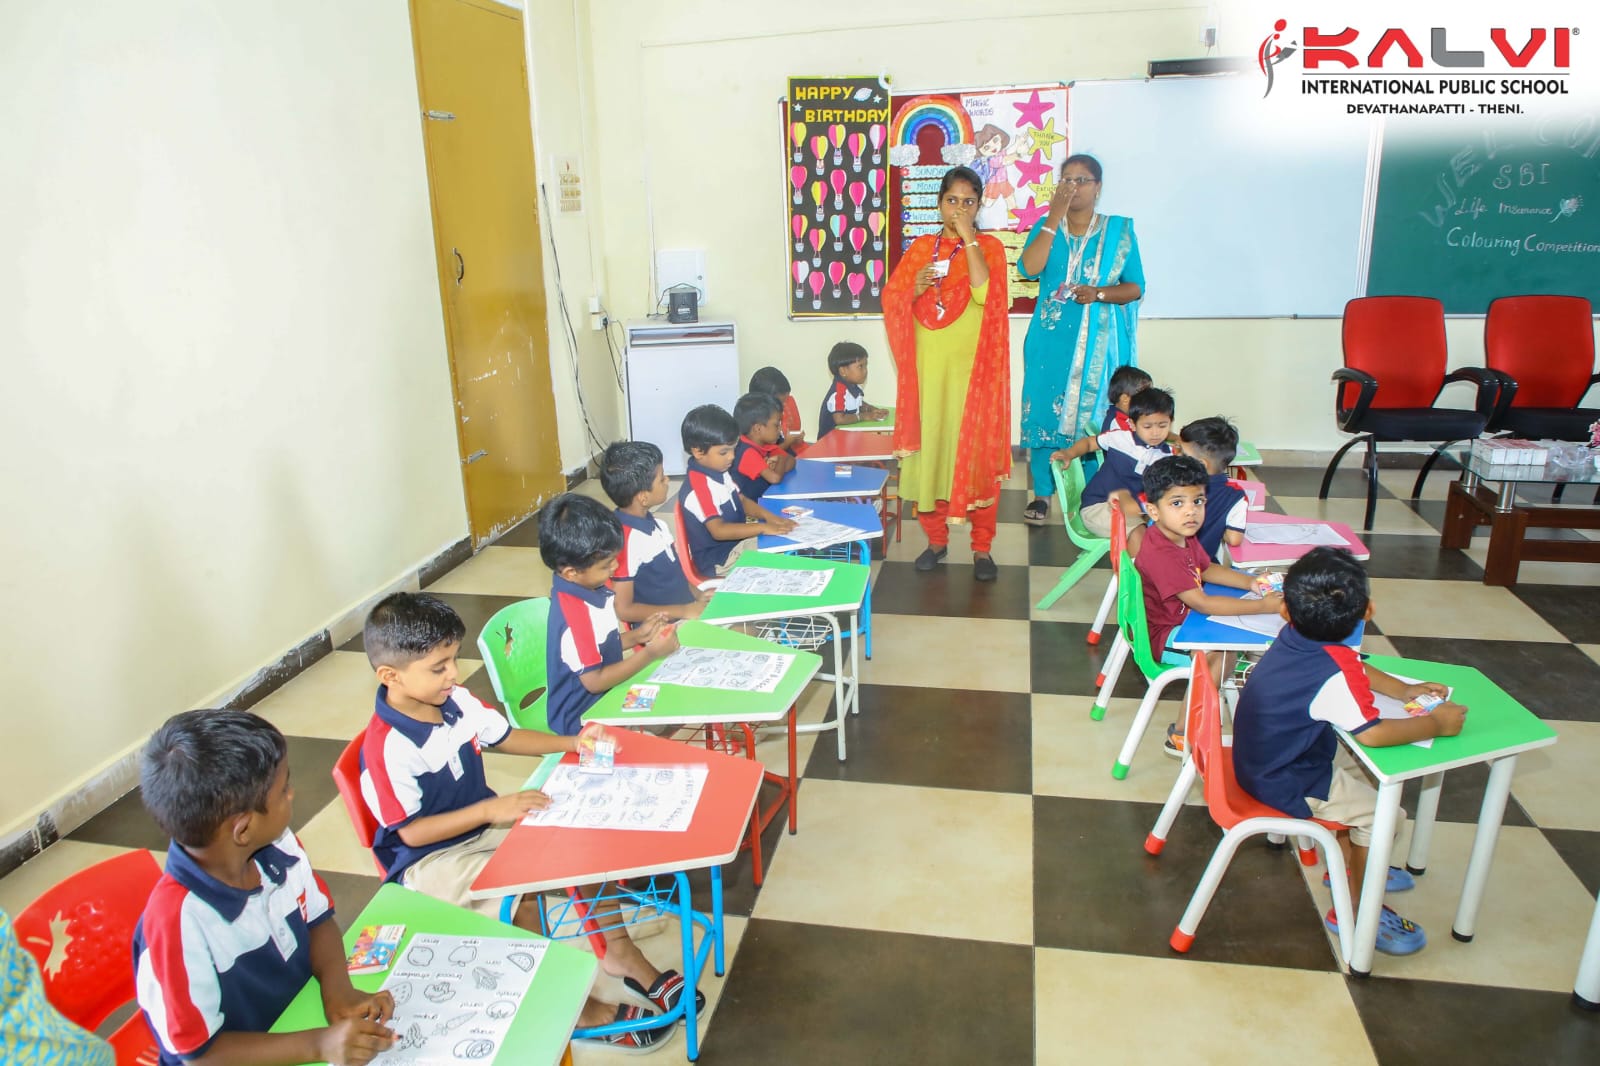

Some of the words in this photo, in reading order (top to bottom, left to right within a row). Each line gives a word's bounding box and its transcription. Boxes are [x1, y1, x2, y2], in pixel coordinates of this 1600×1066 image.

[795, 85, 854, 101] HAPPY
[804, 108, 888, 123] BIRTHDAY
[1492, 162, 1552, 190] SBI
[1446, 226, 1521, 256] Colouring
[1523, 233, 1600, 254] Competition
